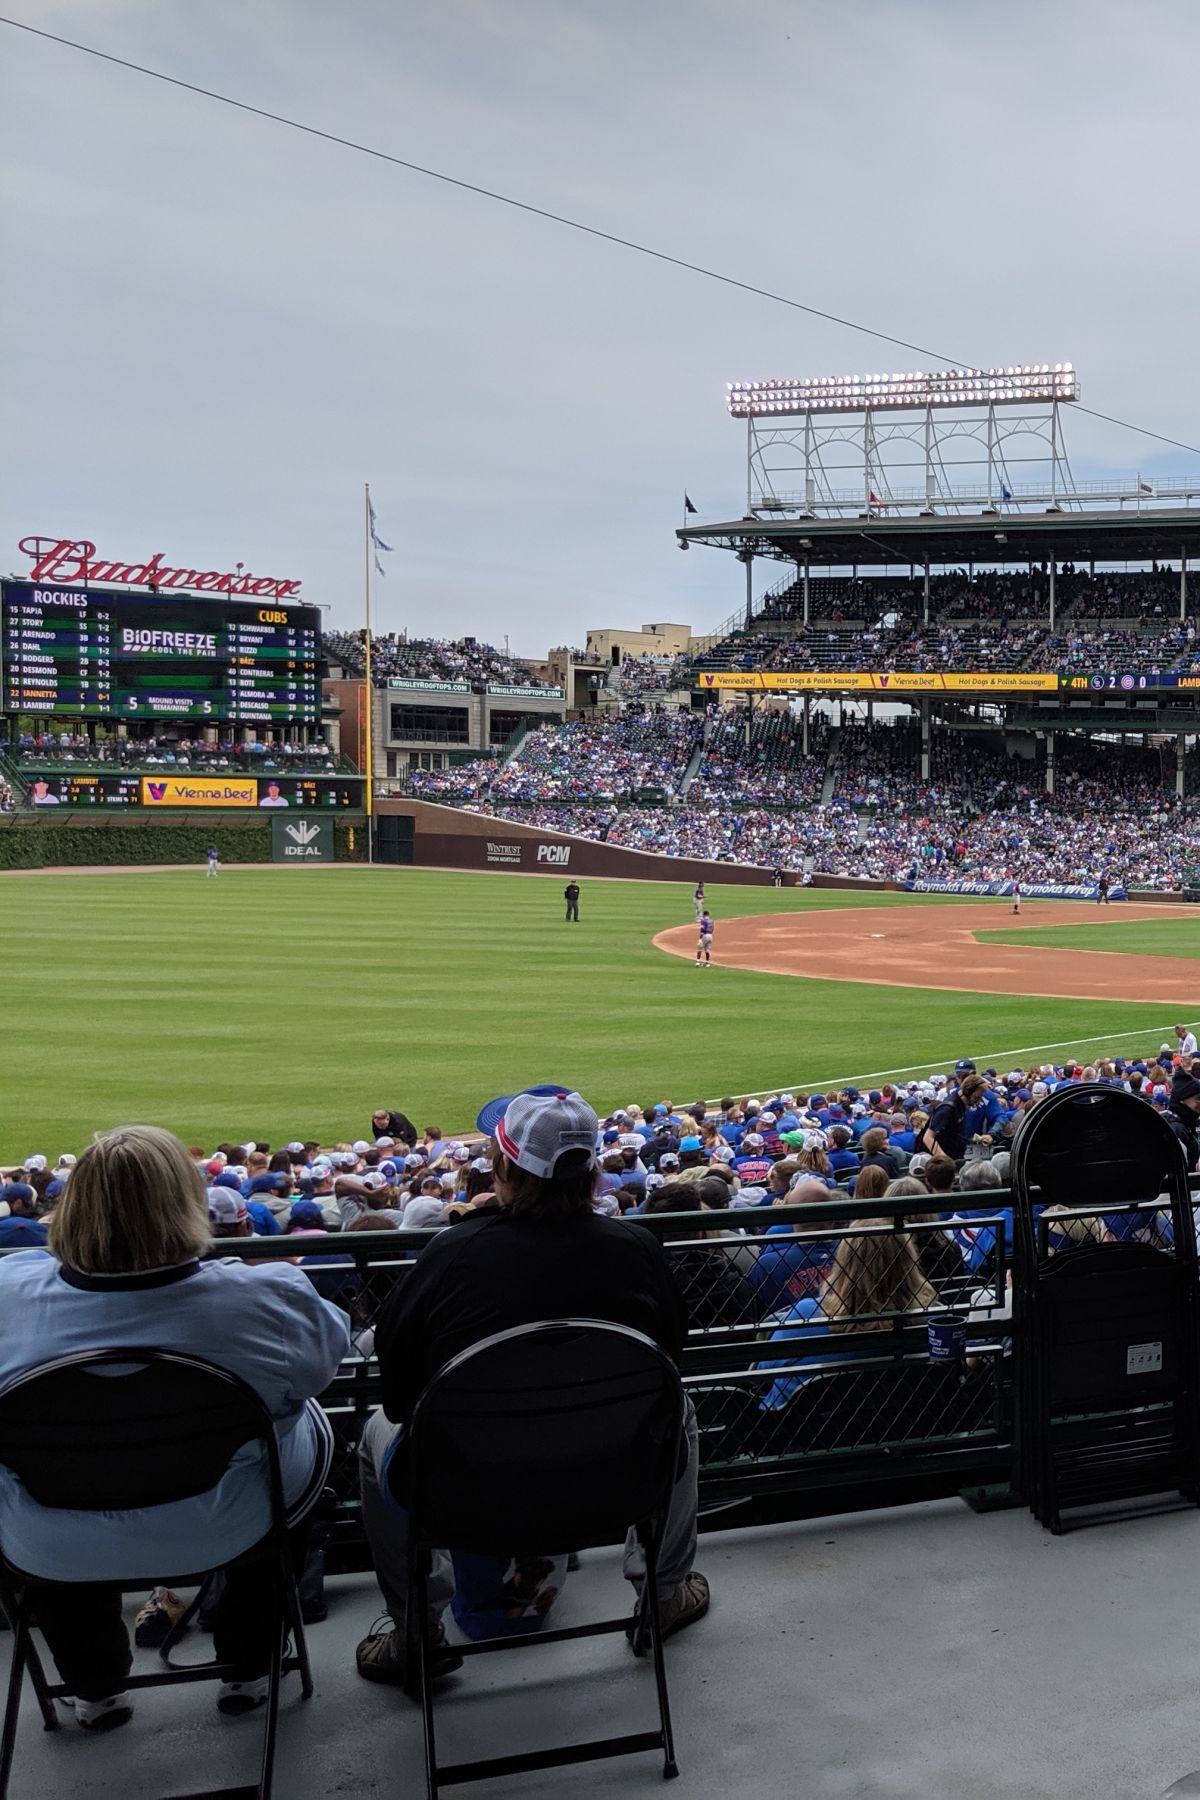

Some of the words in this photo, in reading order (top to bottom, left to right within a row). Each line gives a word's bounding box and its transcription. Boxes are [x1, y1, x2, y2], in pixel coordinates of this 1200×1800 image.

[18, 536, 302, 598] Budweiser
[34, 590, 88, 606] ROCKIES
[22, 606, 43, 615] TAPIA
[259, 610, 288, 624] CUBS
[22, 631, 56, 639] ARENADO
[123, 628, 217, 649] BiOFREEZE
[22, 655, 54, 663] RODGERS
[23, 666, 57, 675] DESMOND
[23, 679, 58, 687] REYNOLDS
[392, 679, 468, 692] WRIGLEYROOFTOPS.COM
[718, 676, 740, 684] Vienna
[741, 676, 756, 686] Beef
[919, 677, 935, 686] Beef
[1019, 678, 1045, 687] Sausage
[1071, 677, 1088, 688] 4TH
[1109, 677, 1115, 688] 2
[1140, 677, 1146, 688] 0
[24, 690, 58, 698] IANNETTA
[490, 686, 561, 698] WRIGLEYROOFTOPS.COM
[24, 702, 55, 710] LAMBERT
[129, 697, 137, 710] 5
[153, 704, 189, 712] REMAINING
[204, 701, 212, 714] 5
[175, 785, 221, 798] Vienna
[224, 787, 254, 802] Beef
[285, 846, 322, 855] IDEAL
[487, 842, 521, 854] WINTRUST
[537, 844, 571, 862] PCM
[912, 880, 960, 892] Reynolds
[960, 882, 990, 894] Wrap
[1019, 884, 1065, 895] Reynolds
[1064, 885, 1095, 897] Wrap
